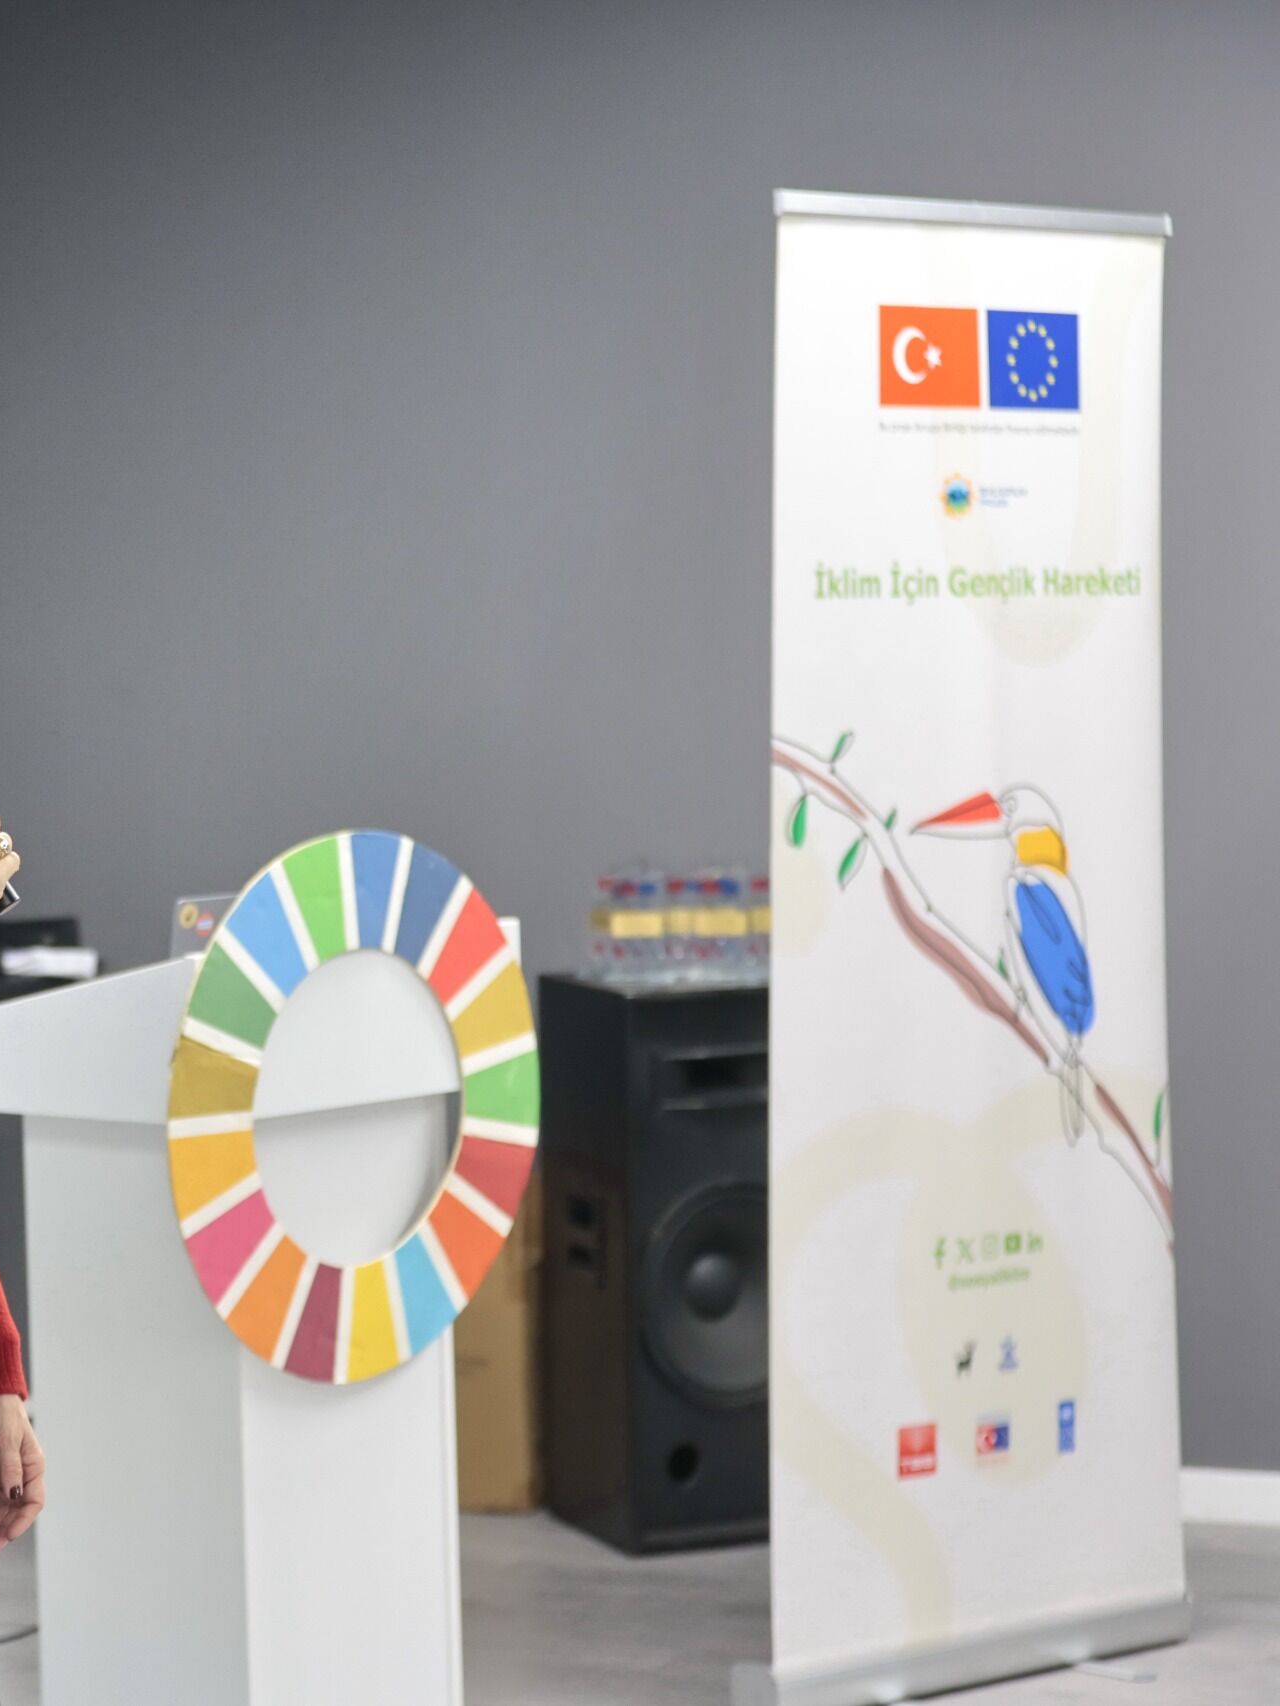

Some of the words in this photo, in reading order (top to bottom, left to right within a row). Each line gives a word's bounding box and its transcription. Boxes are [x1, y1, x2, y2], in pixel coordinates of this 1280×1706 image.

[815, 561, 882, 600] İklim
[890, 561, 940, 606] İçin
[948, 566, 1036, 605] Gençlik
[1042, 565, 1141, 598] Hareketi
